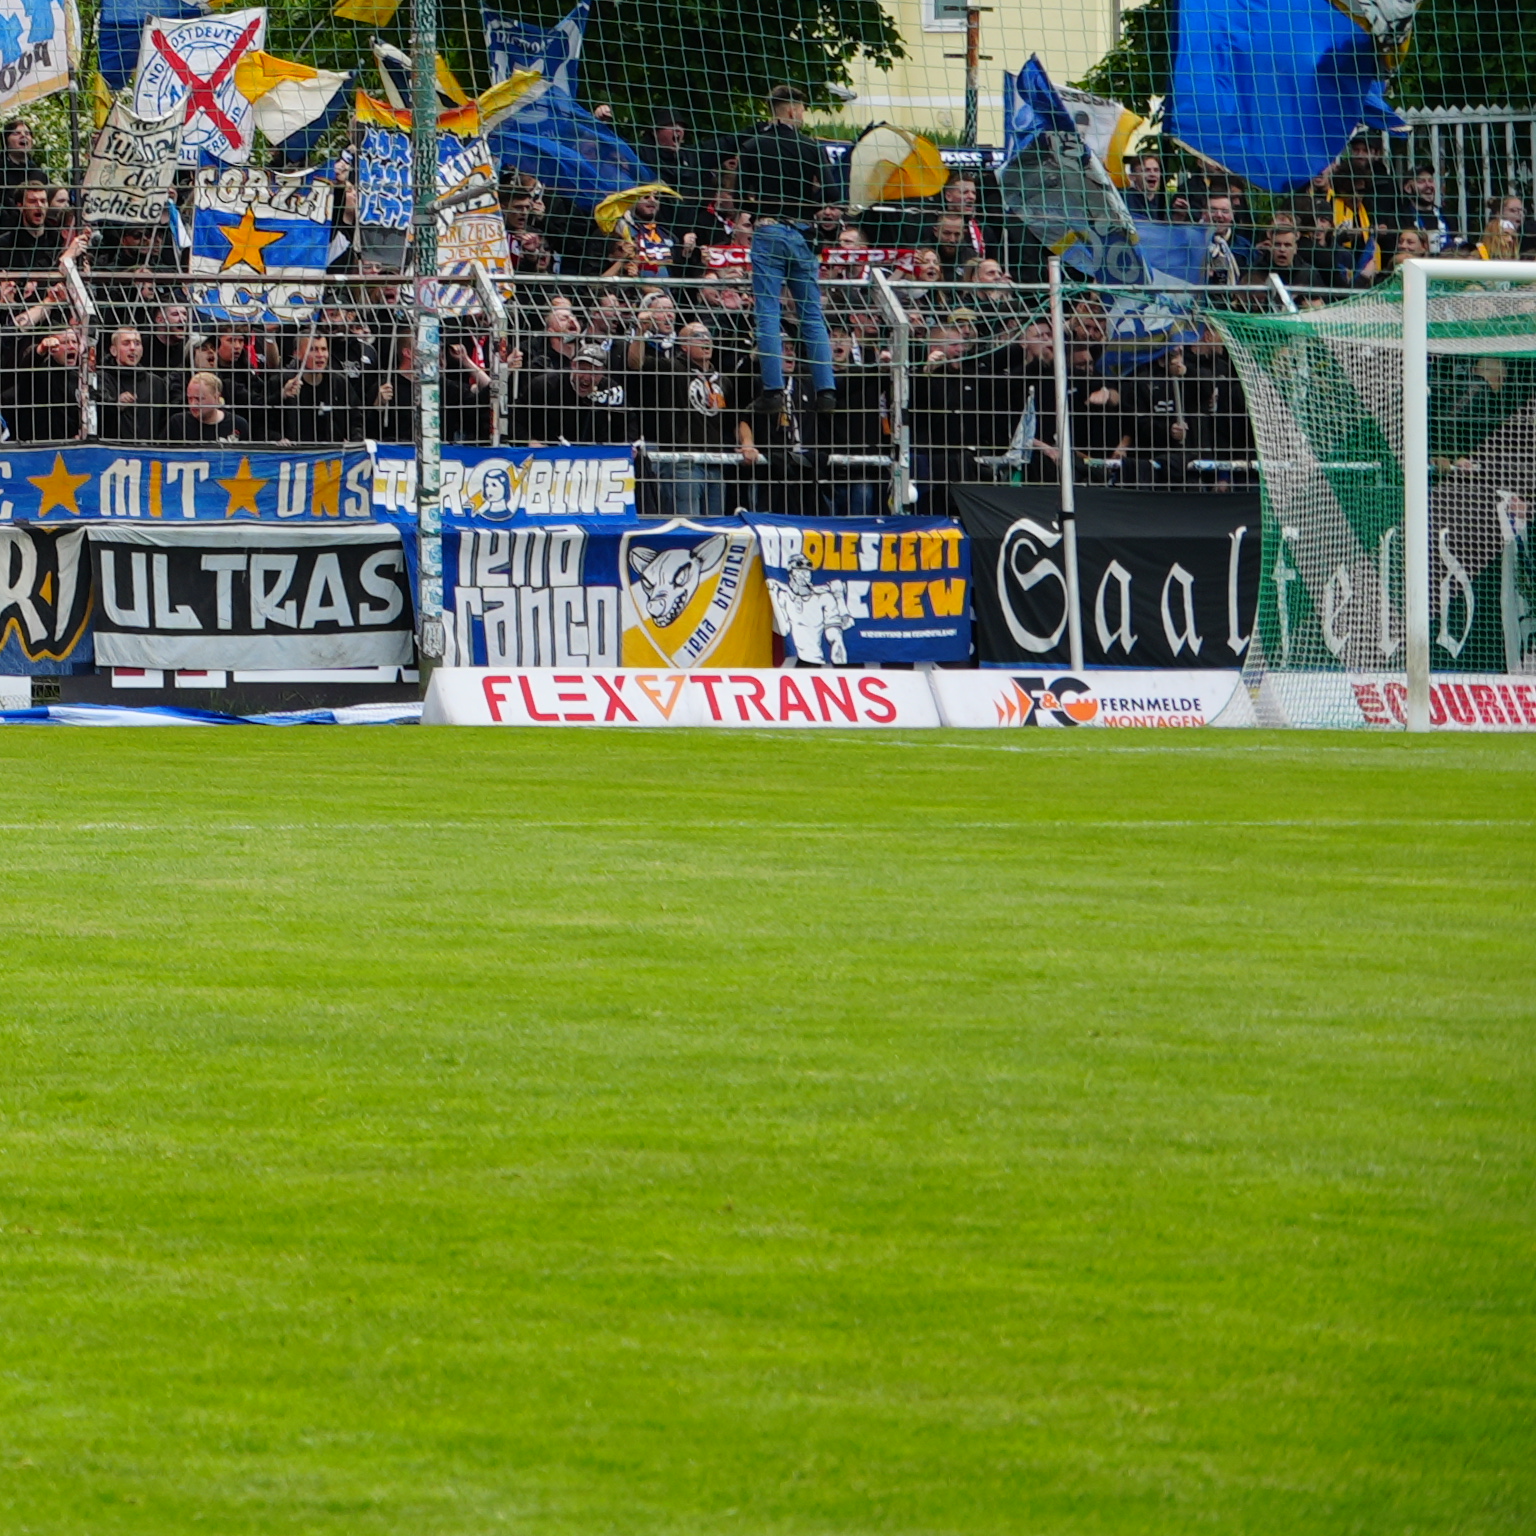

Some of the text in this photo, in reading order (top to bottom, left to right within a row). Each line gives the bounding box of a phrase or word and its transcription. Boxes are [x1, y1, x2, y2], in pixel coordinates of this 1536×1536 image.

[195, 166, 331, 225] FORZA
[100, 457, 208, 519] MIT
[277, 457, 371, 519] UNS
[100, 548, 405, 630] ULTRAS
[845, 577, 967, 620] CREW
[482, 675, 897, 724] FLEX TRANS
[1100, 697, 1203, 713] FERNMELDE
